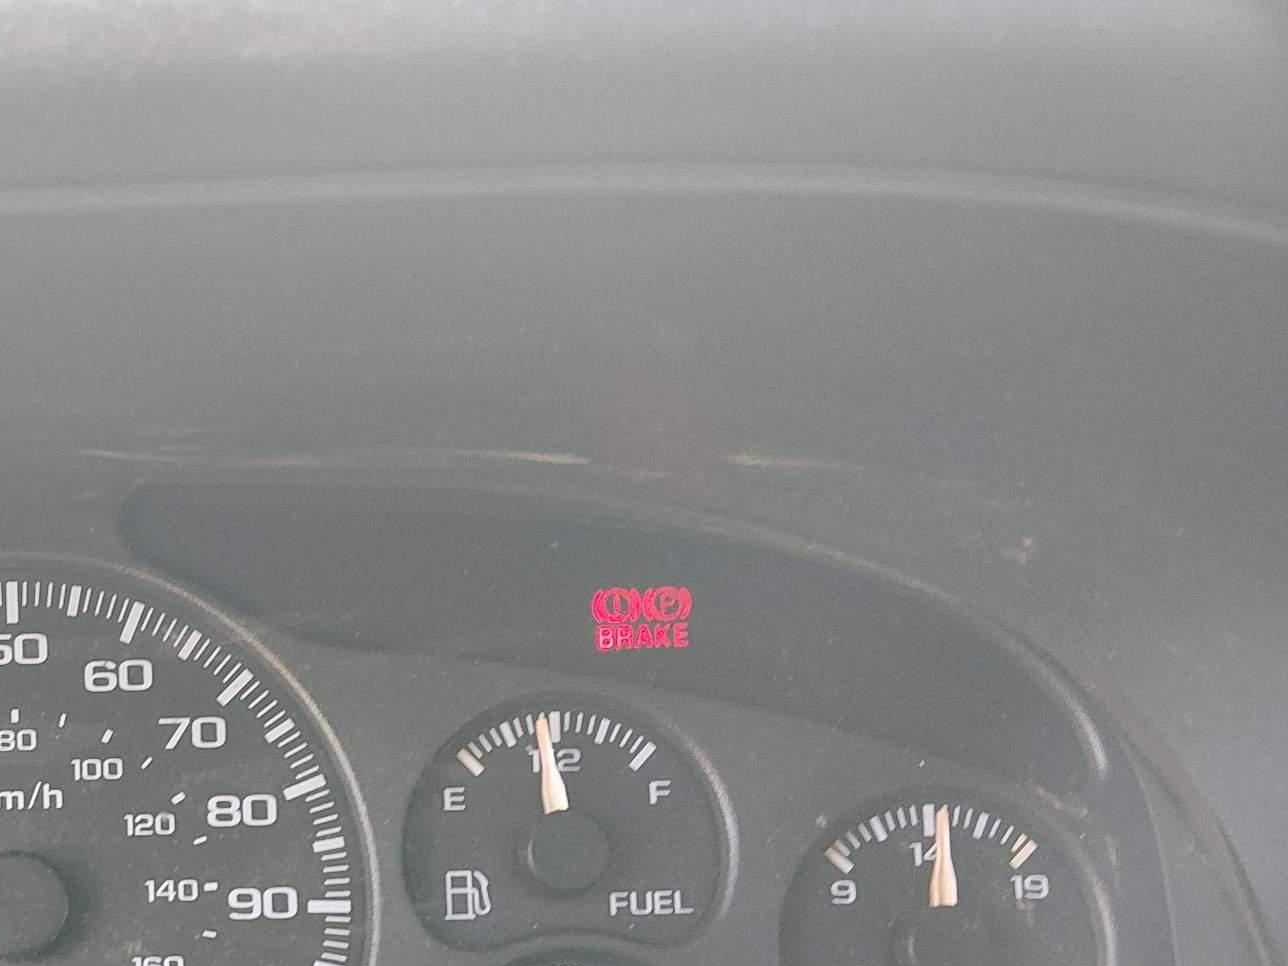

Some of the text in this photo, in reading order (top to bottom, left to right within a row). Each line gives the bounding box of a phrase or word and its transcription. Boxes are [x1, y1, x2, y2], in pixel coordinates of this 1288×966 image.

[596, 623, 690, 650] BRAKE
[85, 660, 152, 691] 60
[159, 717, 225, 749] 70
[72, 759, 122, 780] 100
[444, 788, 465, 810] E
[650, 781, 670, 804] F
[208, 795, 276, 826] 80
[125, 814, 175, 835] 120
[146, 880, 198, 902] 140
[831, 881, 856, 903] 9
[1011, 875, 1048, 899] 19
[228, 887, 297, 919] 90
[610, 891, 693, 915] FUEL
